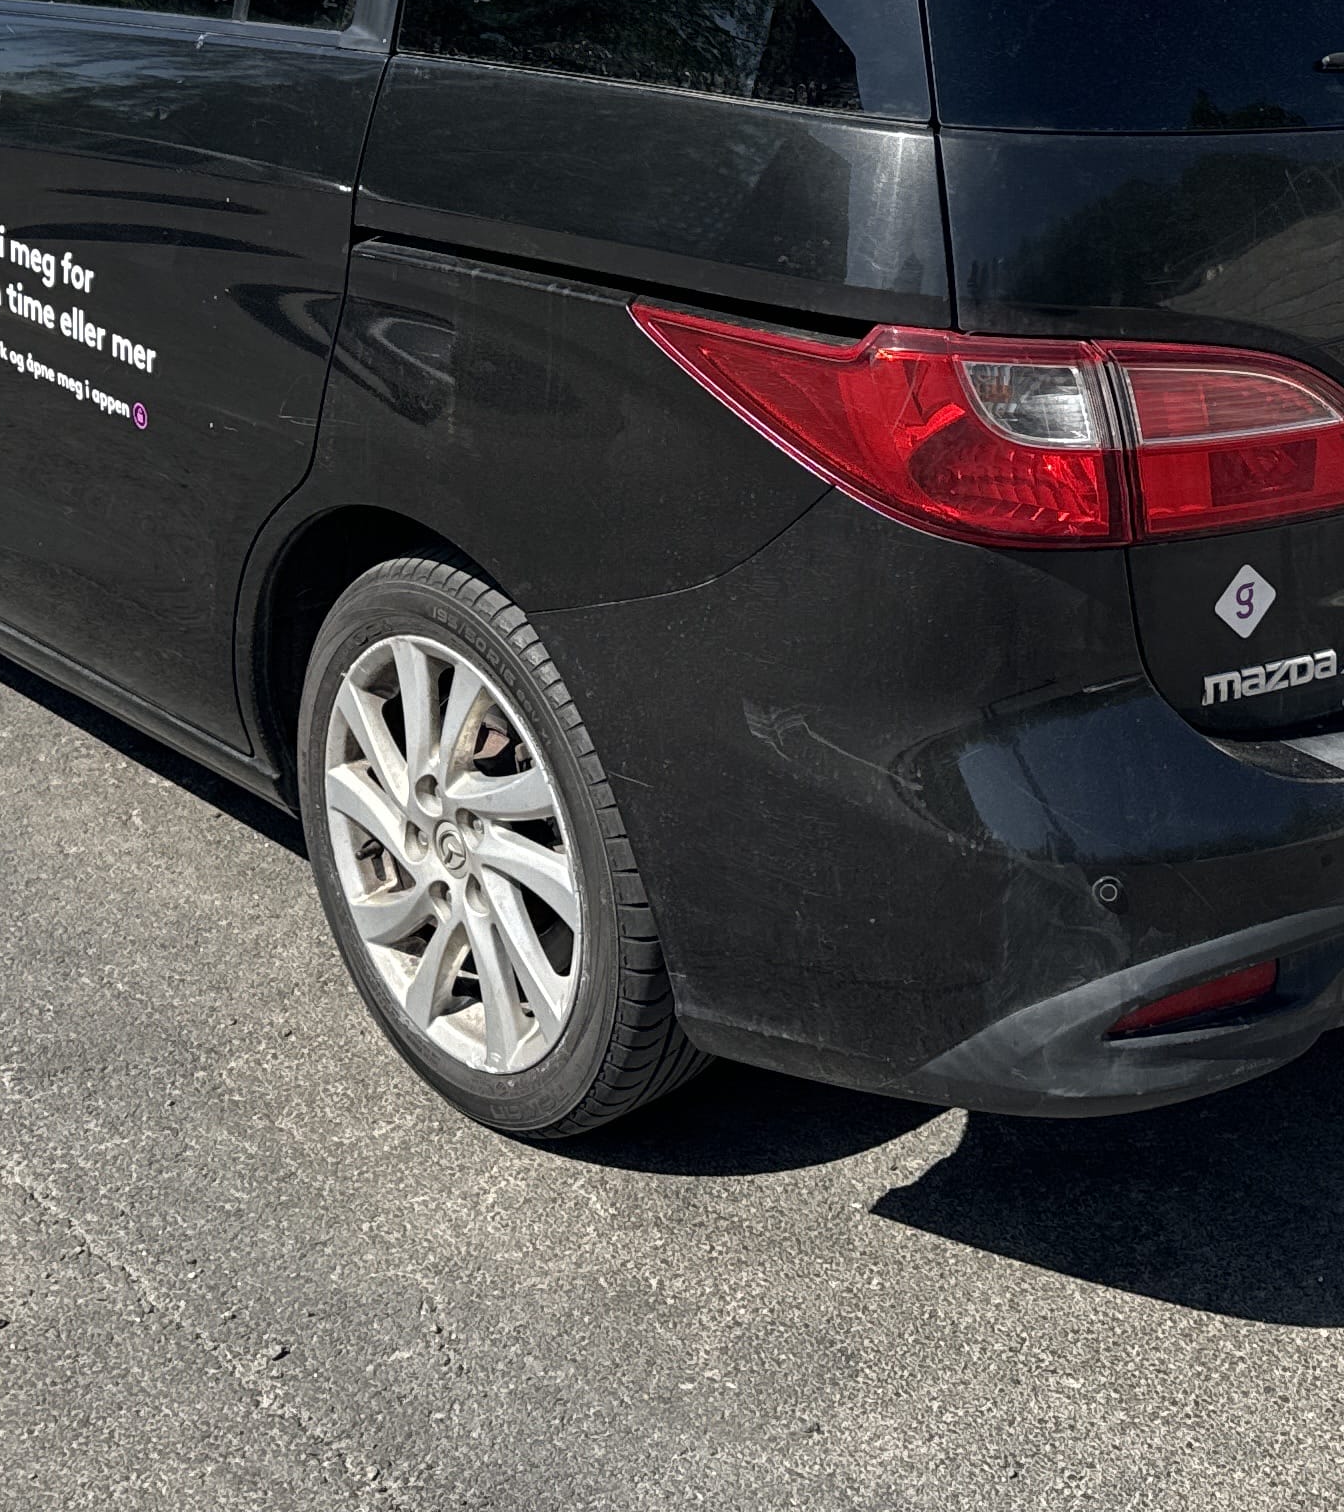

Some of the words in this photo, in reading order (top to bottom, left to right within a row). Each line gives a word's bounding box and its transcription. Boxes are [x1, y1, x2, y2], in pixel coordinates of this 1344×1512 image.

[10, 239, 56, 288] meg
[61, 251, 95, 293] for
[6, 282, 55, 329] time
[60, 306, 106, 351] eller
[111, 333, 157, 373] mer
[9, 350, 25, 373] og
[26, 352, 56, 382] åpne
[57, 371, 84, 401] meg
[84, 379, 91, 399] i
[91, 388, 131, 419] appen
[1236, 581, 1255, 619] g
